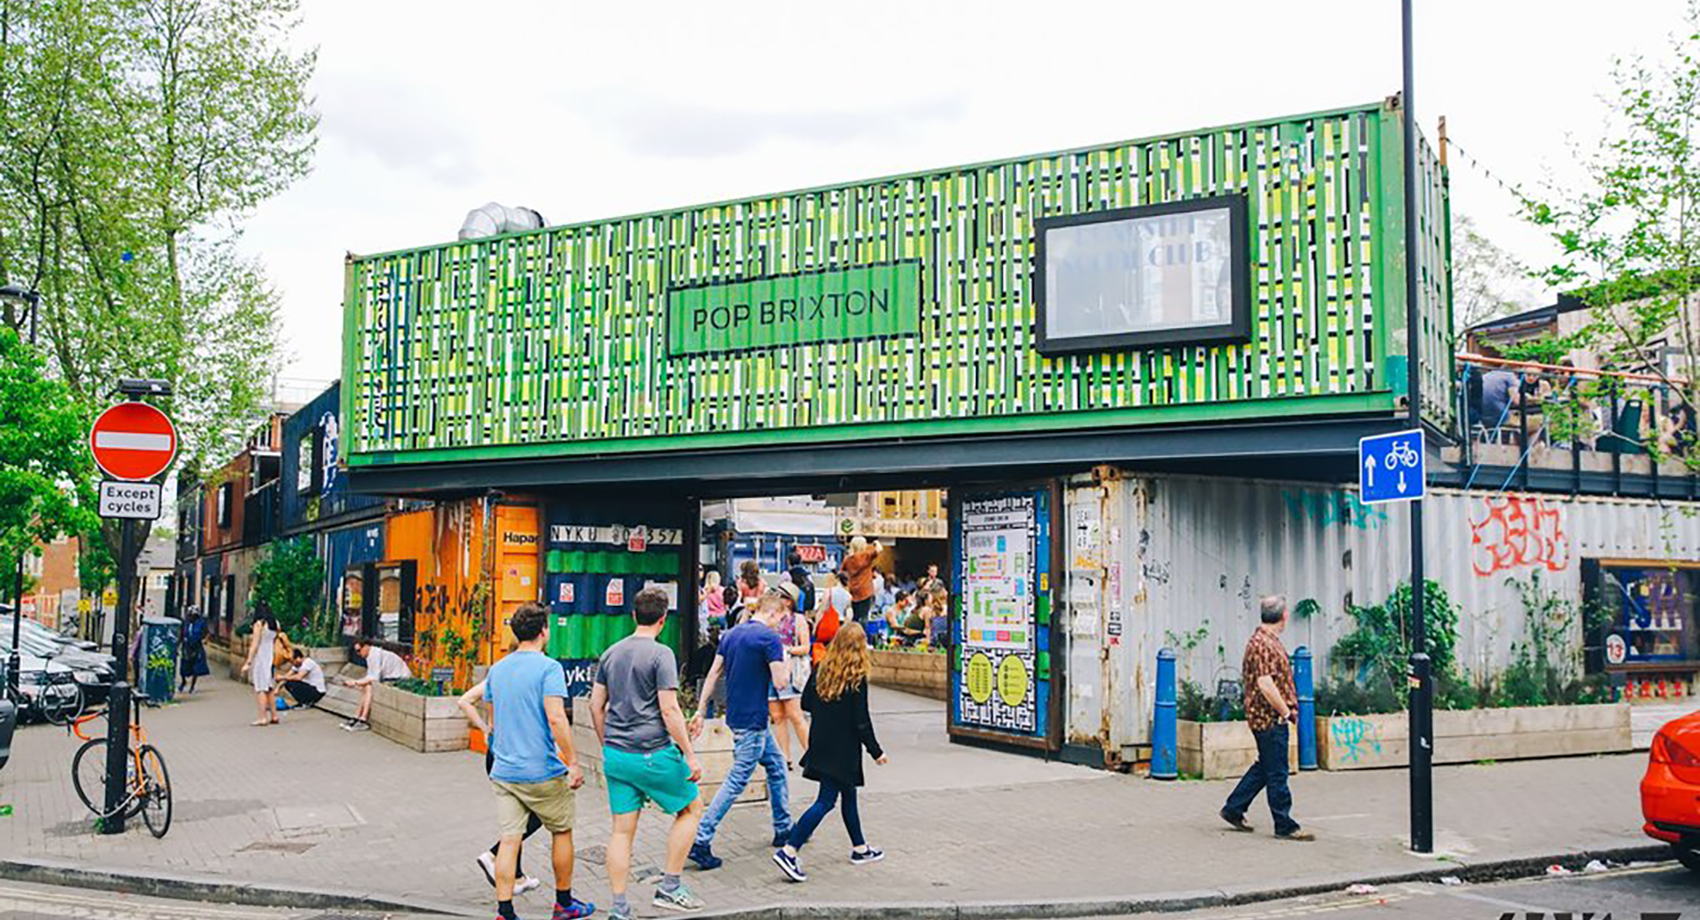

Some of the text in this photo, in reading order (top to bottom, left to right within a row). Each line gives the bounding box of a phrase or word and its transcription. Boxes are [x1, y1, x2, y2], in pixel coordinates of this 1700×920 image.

[693, 288, 889, 332] POP BRIXTON
[106, 486, 155, 500] Except
[107, 501, 151, 513] cycles
[551, 526, 598, 541] NYKU
[1608, 642, 1623, 659] 13
